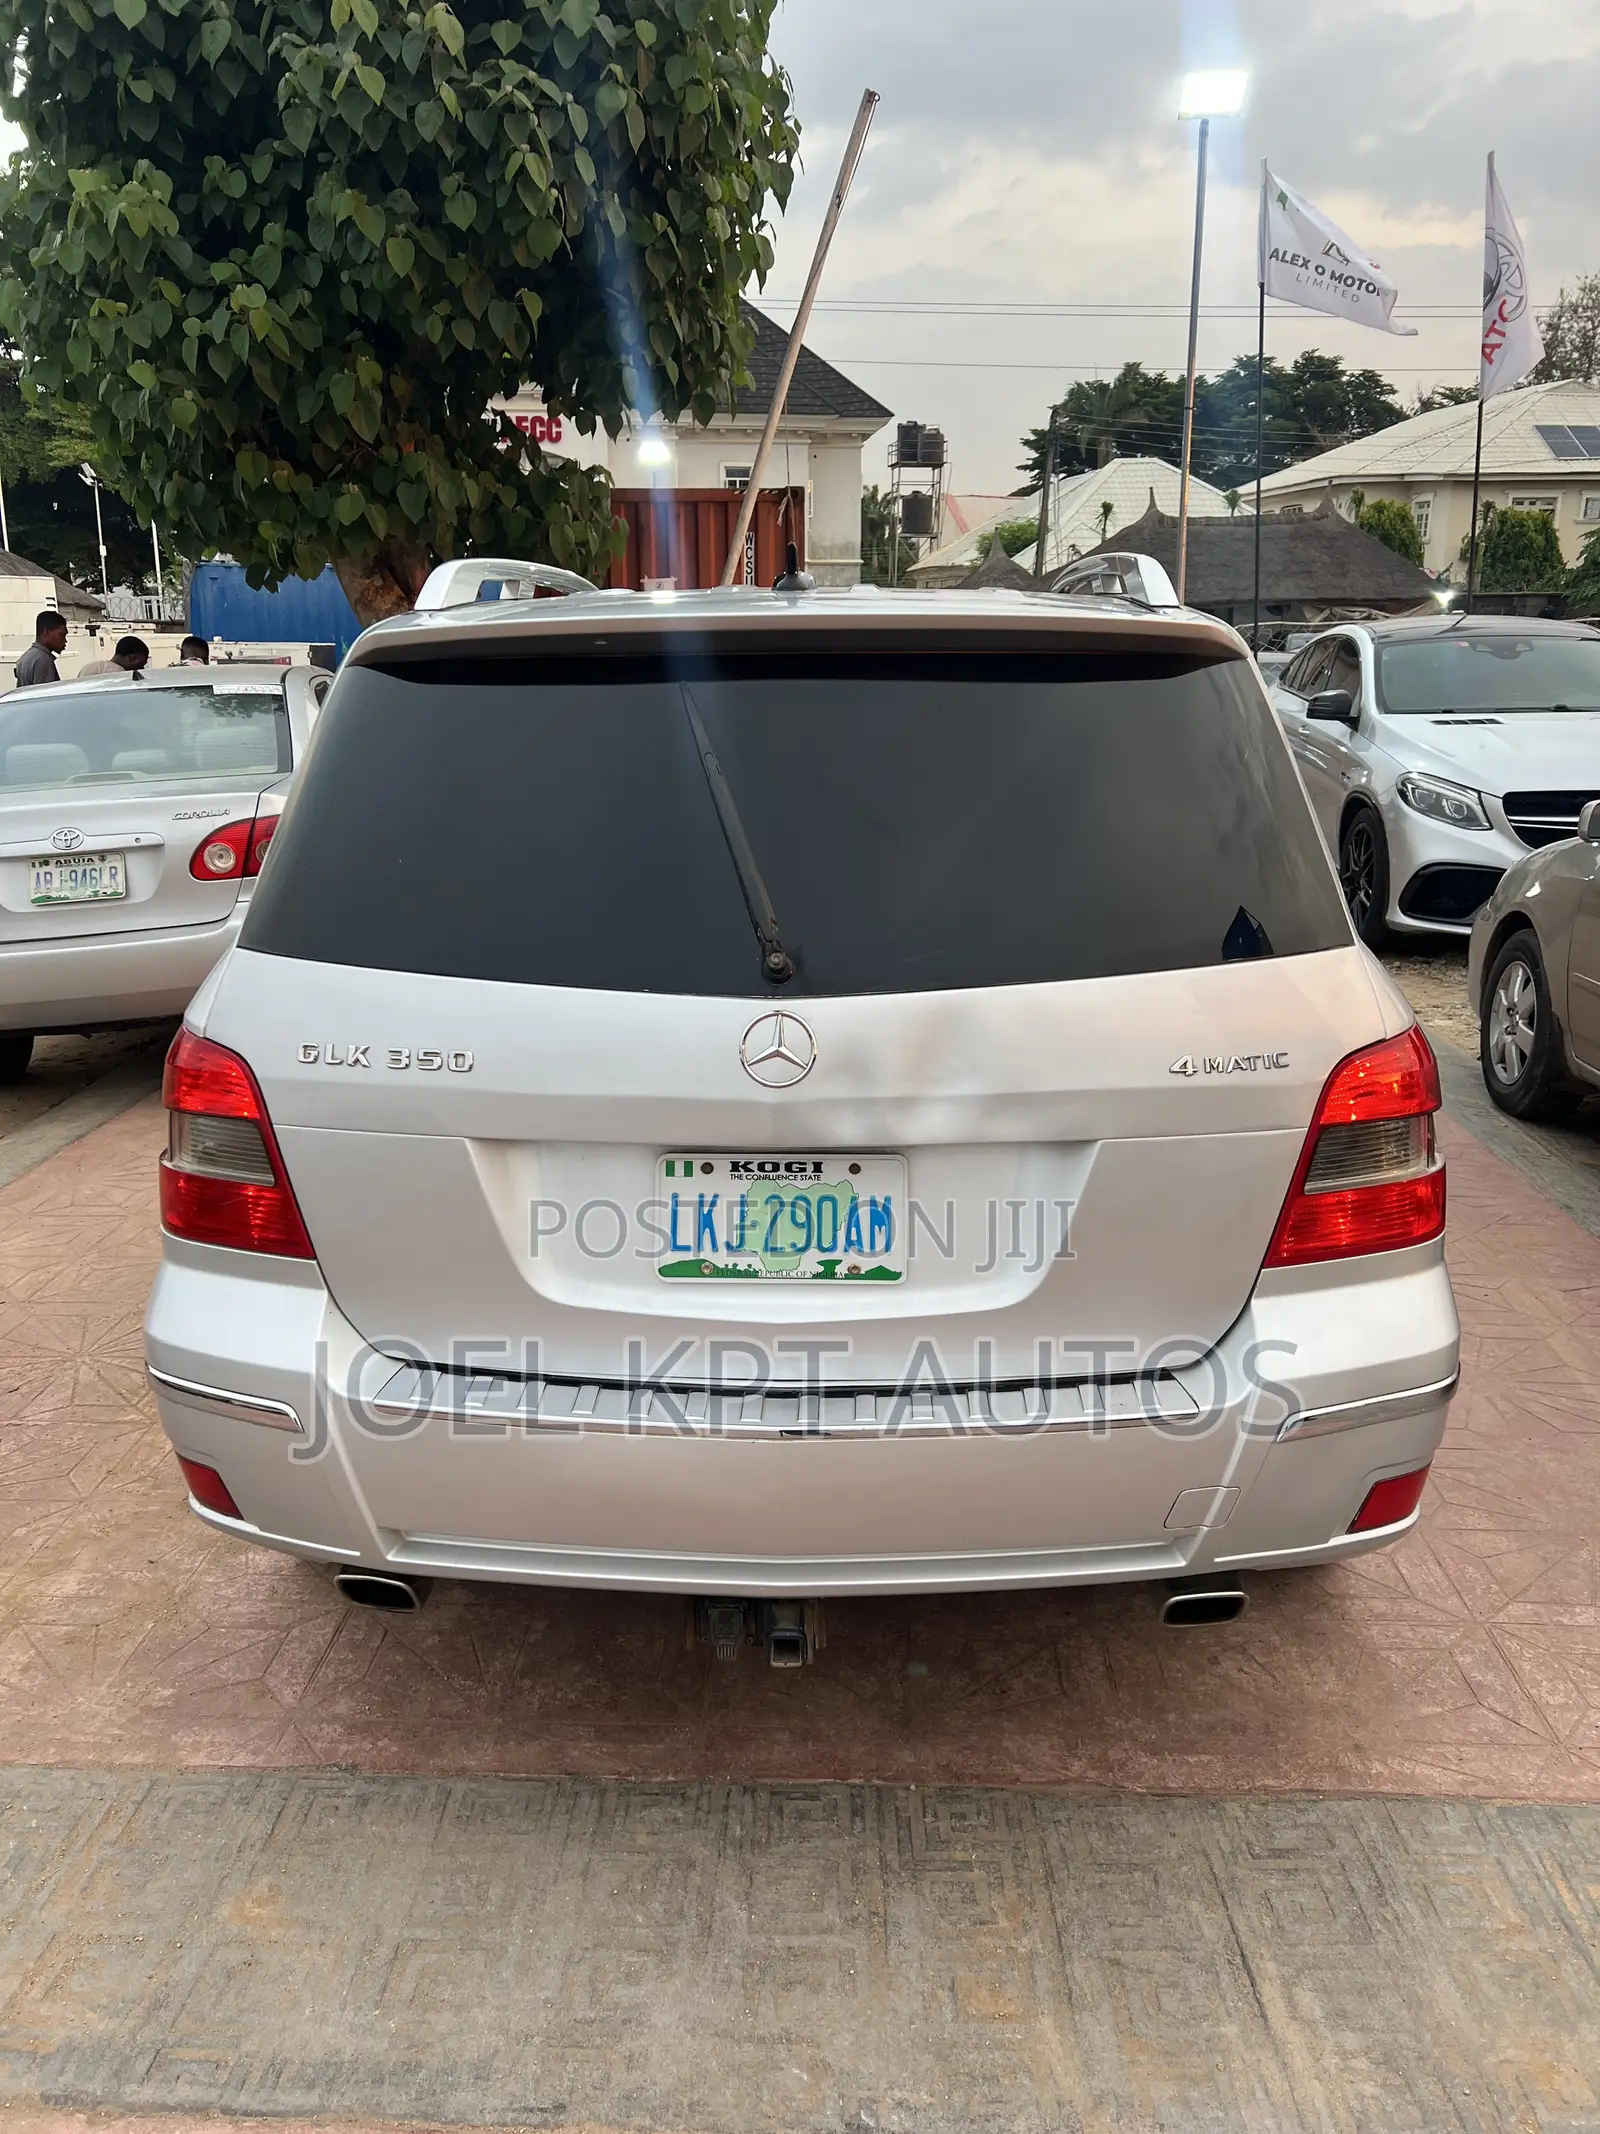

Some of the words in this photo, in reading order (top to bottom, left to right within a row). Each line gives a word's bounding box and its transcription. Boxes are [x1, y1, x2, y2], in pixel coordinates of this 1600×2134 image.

[1269, 248, 1312, 270] ALEX
[1315, 264, 1326, 276] O
[1296, 273, 1360, 303] LIMITED
[172, 808, 231, 820] COROLLA
[55, 857, 95, 865] ABUJA
[297, 1042, 371, 1069] GLK
[387, 1047, 474, 1073] 350
[729, 1161, 824, 1173] KOGI
[800, 1174, 822, 1182] STATE
